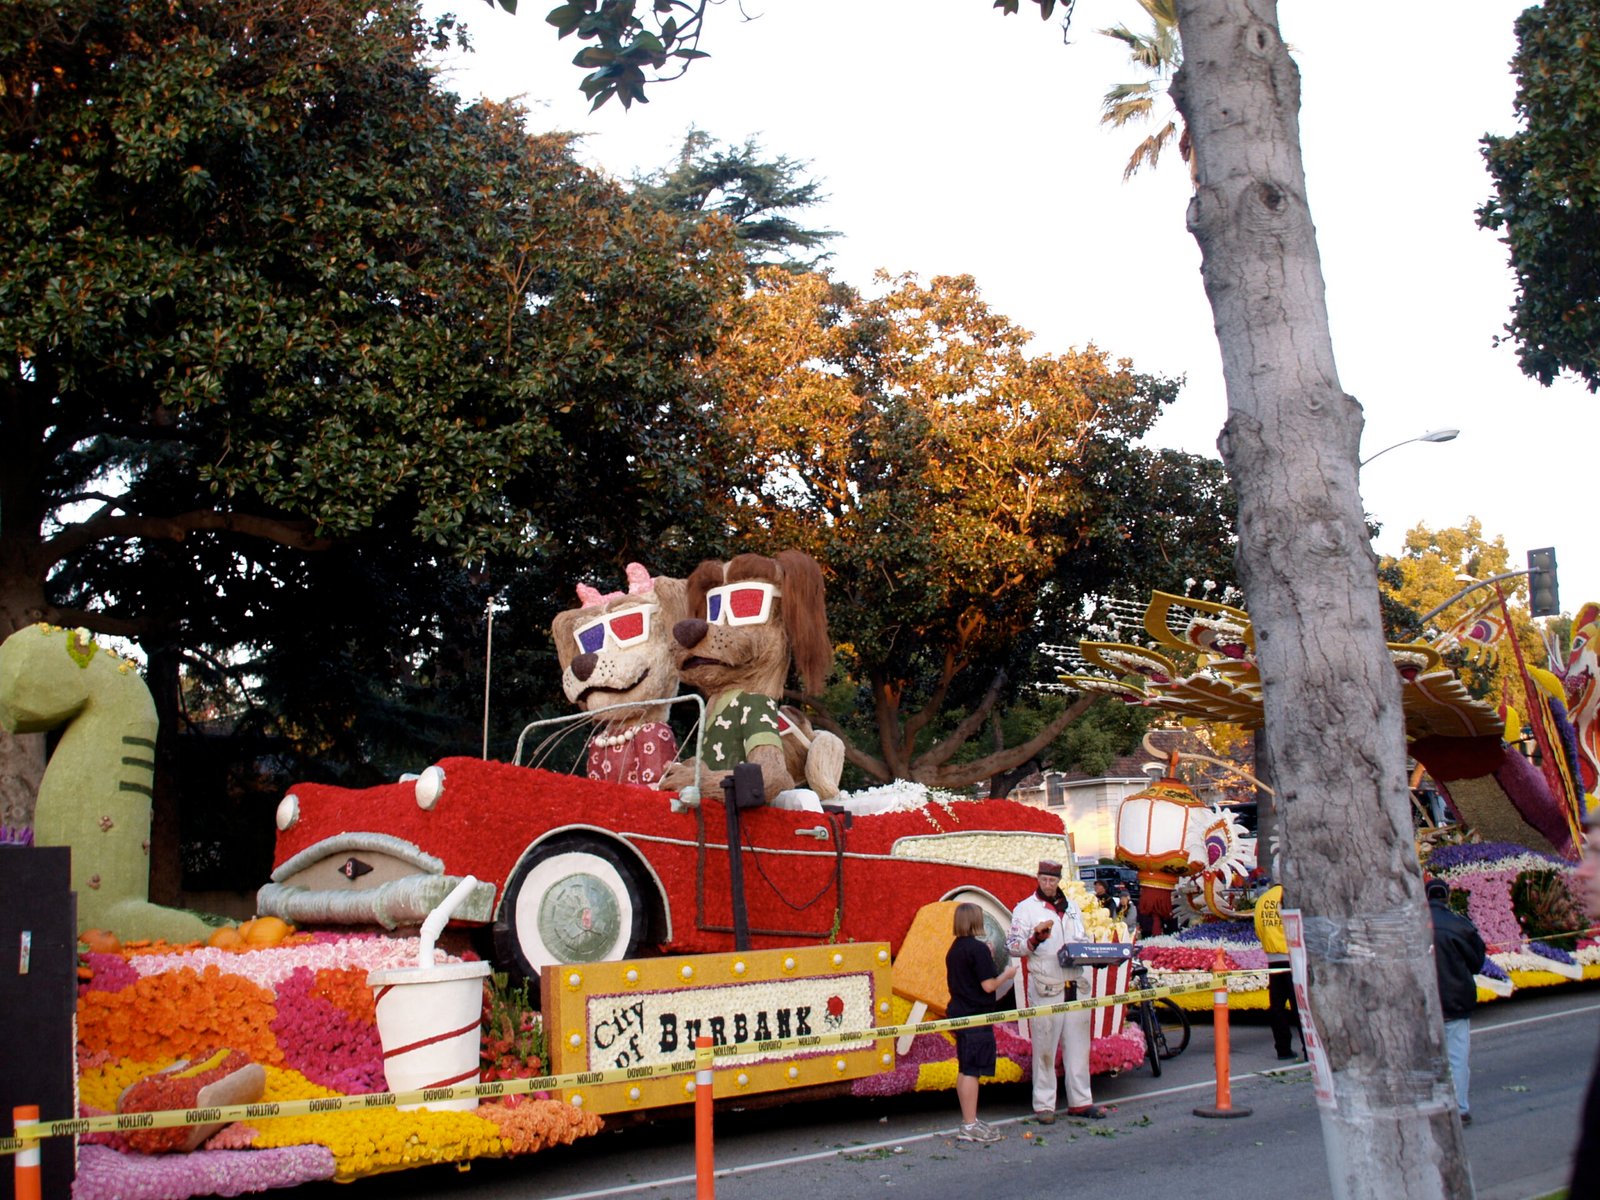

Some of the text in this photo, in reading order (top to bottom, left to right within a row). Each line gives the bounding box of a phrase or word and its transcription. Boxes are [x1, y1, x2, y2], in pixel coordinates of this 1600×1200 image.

[1261, 911, 1280, 919] EVEN
[594, 1000, 644, 1049] City
[658, 1006, 812, 1053] BURBANK
[614, 1033, 644, 1068] of
[713, 1045, 738, 1057] CAUTION
[758, 1039, 783, 1051] CUIDADO
[798, 1034, 822, 1046] CAUTION
[51, 1060, 696, 1136] CAUTION CUIDADO CAUTION CUIDADO CAUTION CUIDADO CAUTION CUIDADO CAUTION CUIDADO CAUTION CUIDADO
